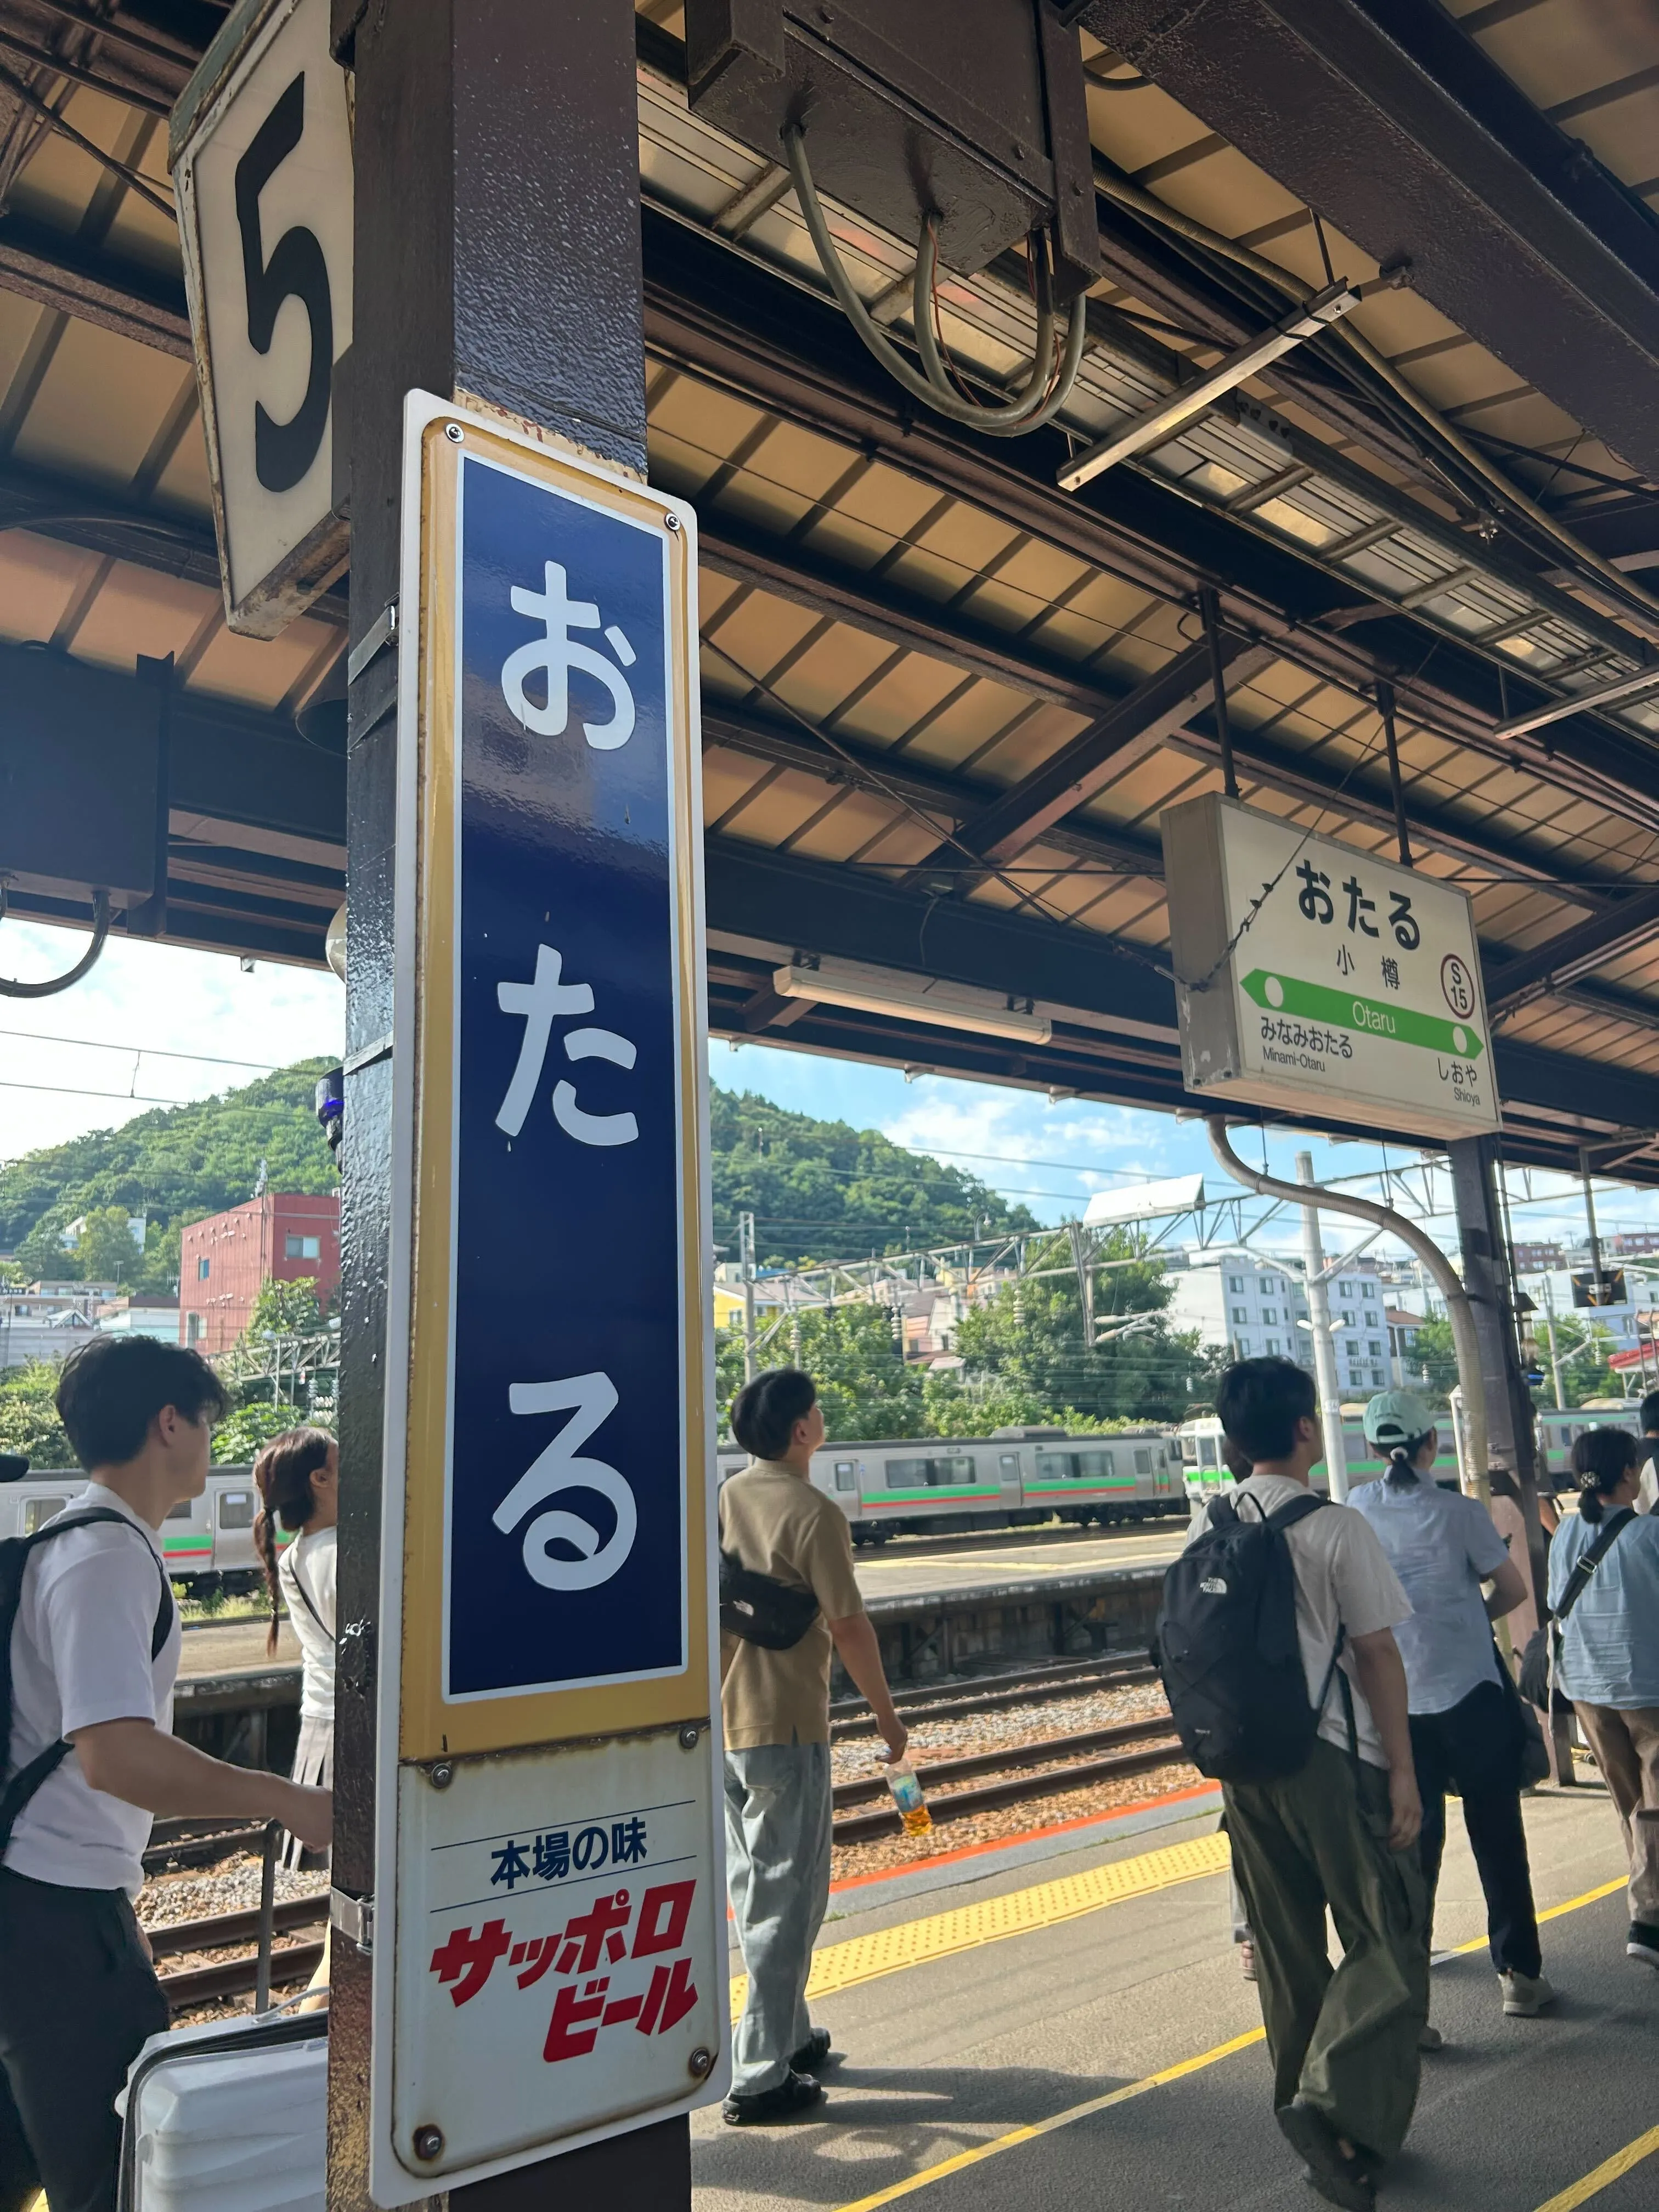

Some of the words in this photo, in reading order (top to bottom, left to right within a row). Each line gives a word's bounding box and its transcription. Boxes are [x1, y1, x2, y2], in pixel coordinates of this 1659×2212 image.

[234, 71, 333, 493] 5
[1296, 859, 1420, 951] おたる
[1336, 944, 1400, 990] 小樽
[1451, 962, 1462, 985] S
[1352, 1001, 1396, 1034] Otaru
[1451, 985, 1468, 1011] 15
[1261, 1016, 1353, 1059] みなみおたる
[1262, 1045, 1325, 1073] Minami-Otaru
[493, 560, 638, 1591] おたる
[1438, 1058, 1478, 1087] しおや
[1454, 1086, 1481, 1107] Shioya
[490, 1816, 648, 1889] 本場の味
[430, 1879, 697, 2008] サッポロ
[543, 1957, 698, 2063] ビール
